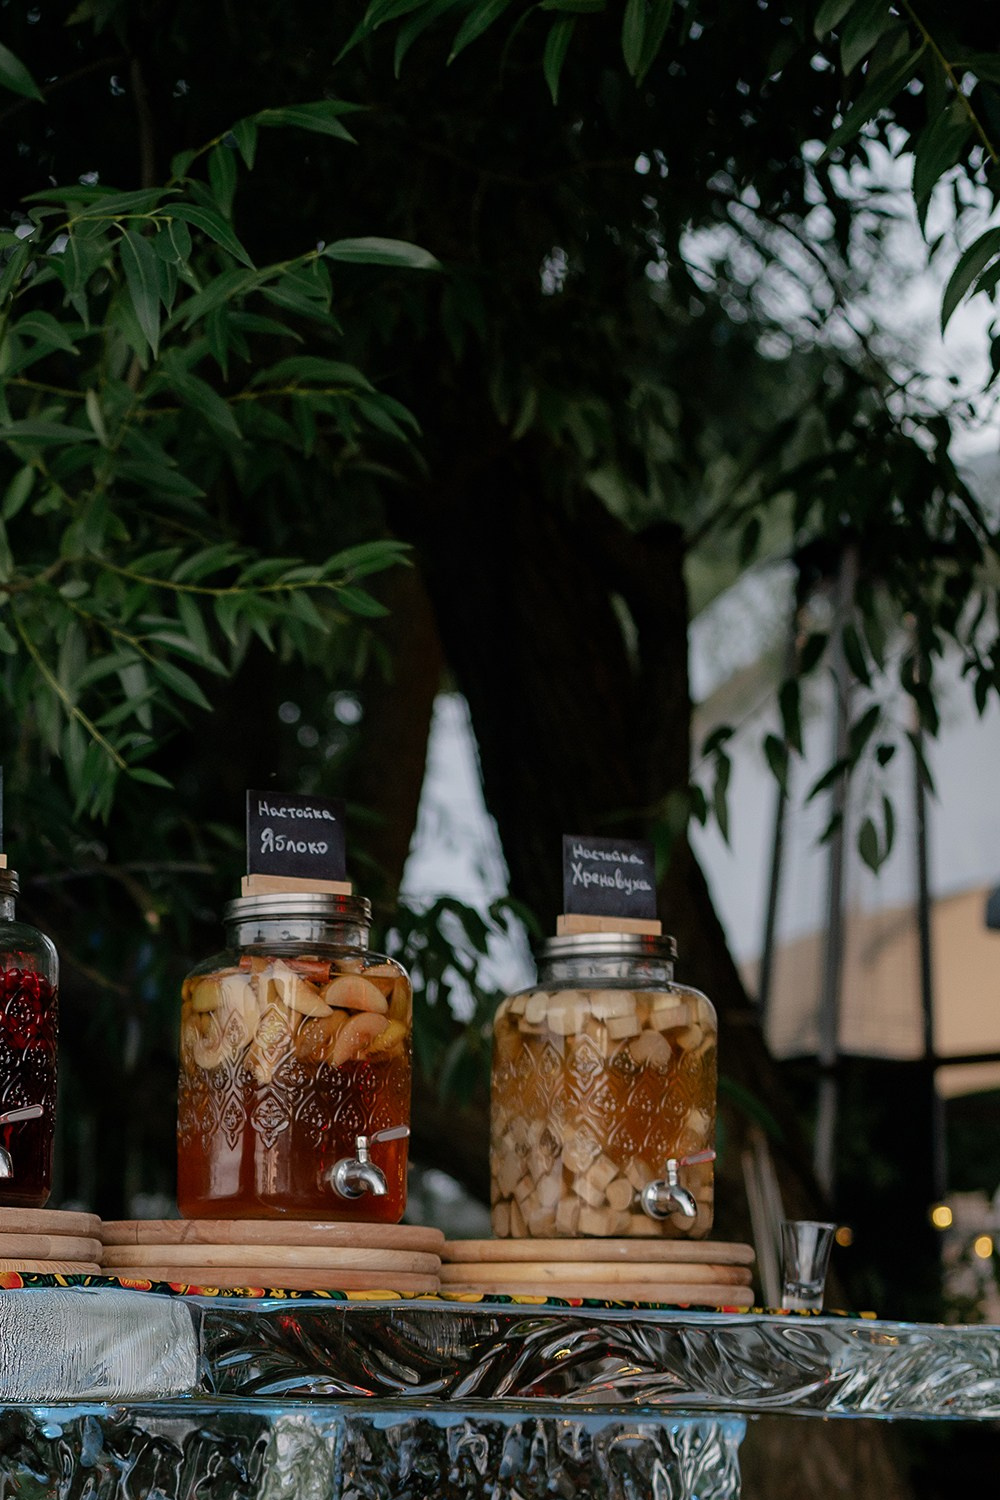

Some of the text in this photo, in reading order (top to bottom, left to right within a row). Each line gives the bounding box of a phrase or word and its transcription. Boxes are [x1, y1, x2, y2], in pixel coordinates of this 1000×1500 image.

[258, 800, 336, 821] Настойка
[260, 827, 329, 855] Яблоко
[572, 843, 645, 865] Настойка
[570, 861, 653, 896] Хреновуха
